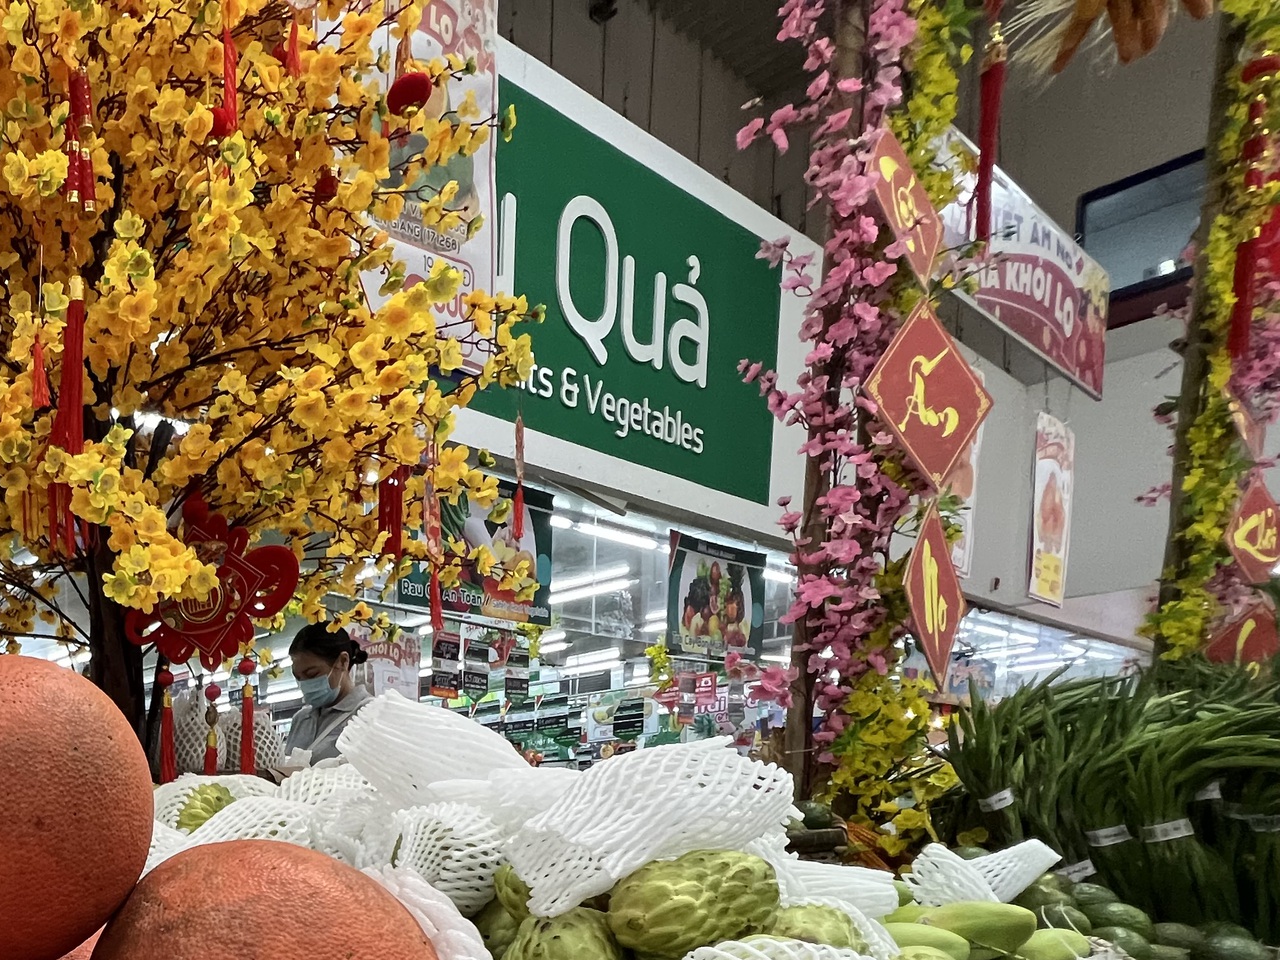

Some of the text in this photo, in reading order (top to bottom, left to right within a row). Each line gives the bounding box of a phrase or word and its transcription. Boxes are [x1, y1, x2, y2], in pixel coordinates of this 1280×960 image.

[390, 219, 420, 238] GIANG
[556, 194, 710, 389] Quả
[1005, 259, 1053, 309] KHỎI
[1054, 281, 1075, 338] LO
[560, 367, 580, 408] &
[582, 372, 705, 455] Vegetables
[401, 578, 423, 597] Rau
[442, 588, 457, 603] An
[389, 644, 400, 661] LO
